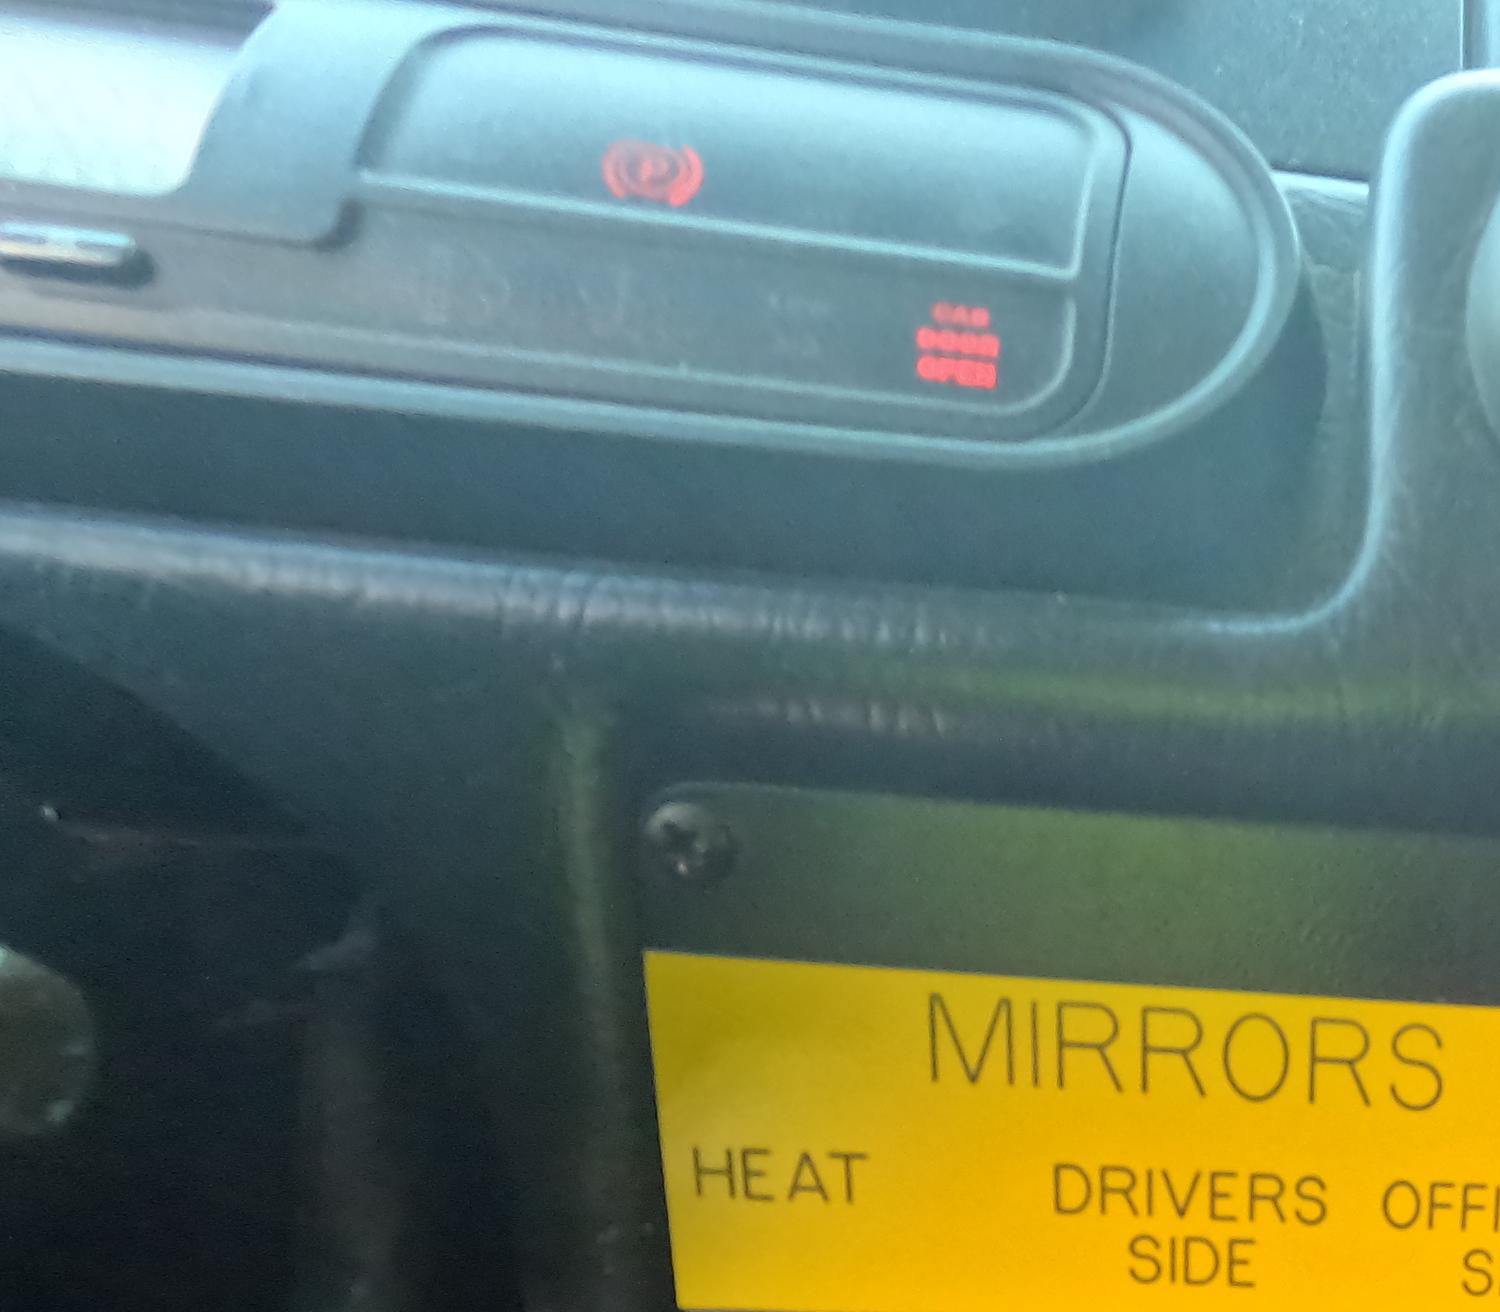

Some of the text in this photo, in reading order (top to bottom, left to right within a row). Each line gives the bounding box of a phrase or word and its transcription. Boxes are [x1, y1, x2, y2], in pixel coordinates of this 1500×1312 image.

[916, 354, 997, 390] OPEN
[928, 992, 1444, 1112] MIRRORS
[692, 1147, 868, 1204] HEAT
[1053, 1162, 1328, 1227] DRIVERS
[1128, 1235, 1256, 1289] SIDE
